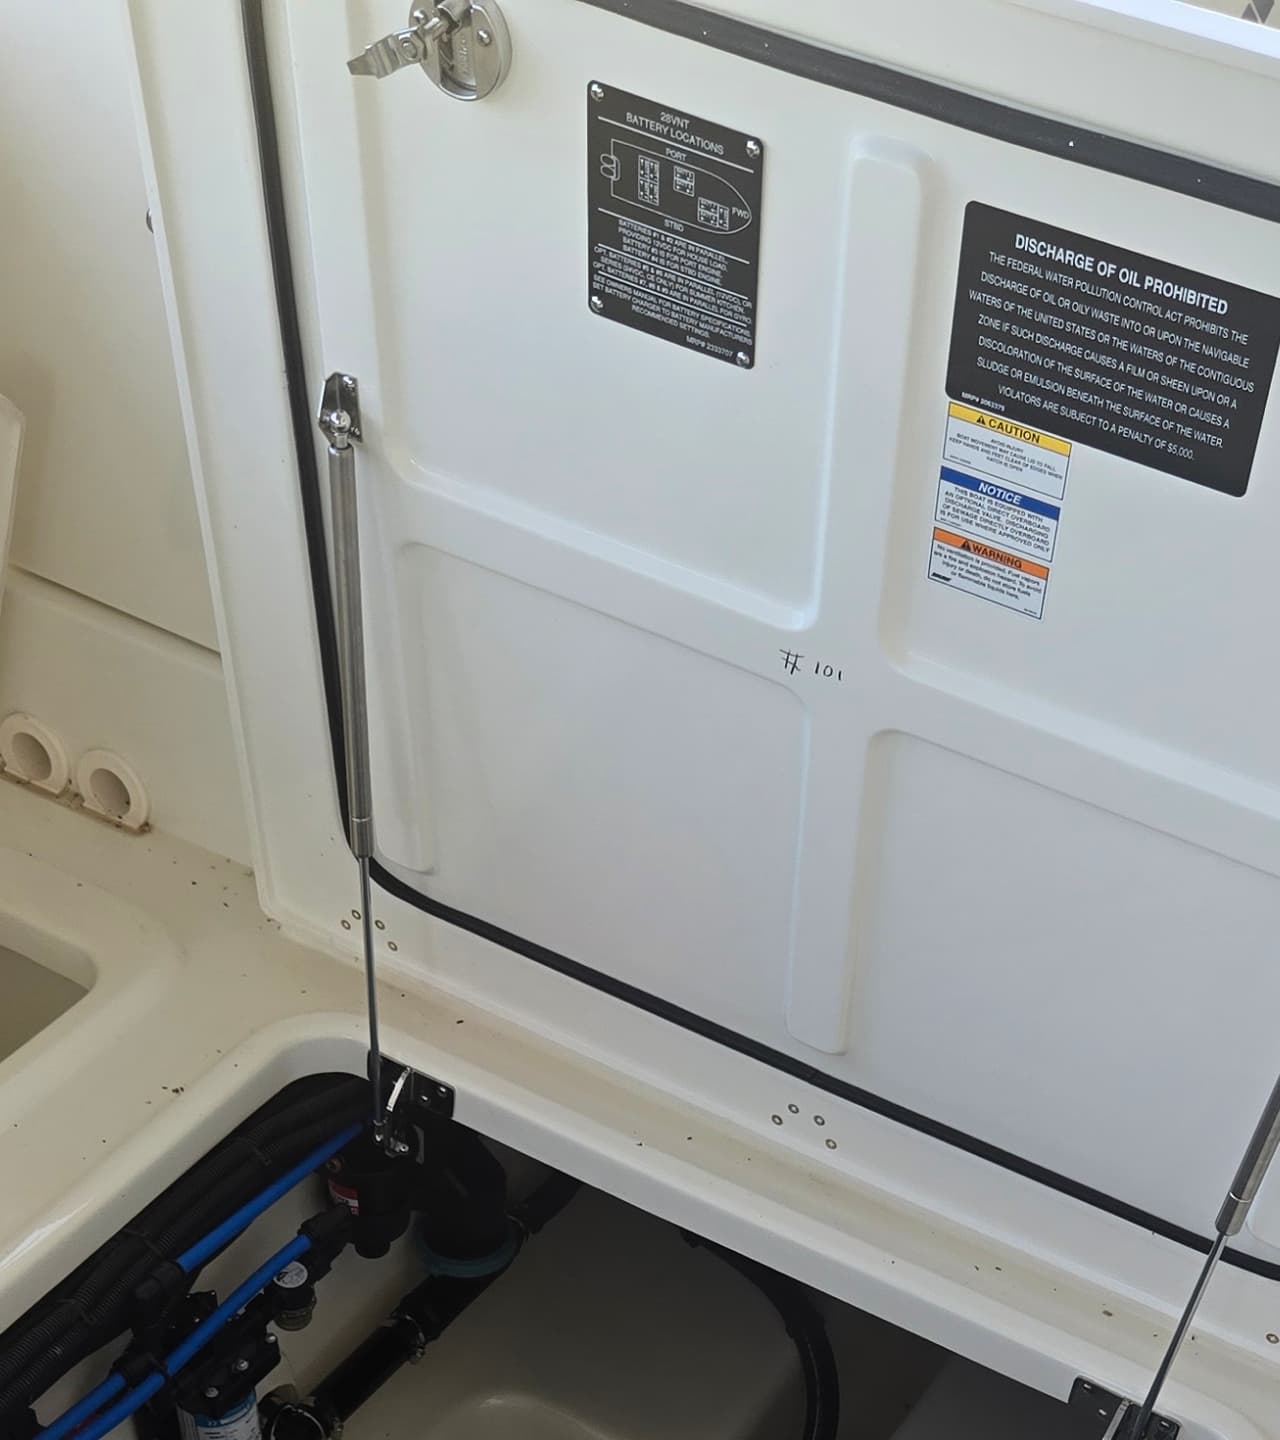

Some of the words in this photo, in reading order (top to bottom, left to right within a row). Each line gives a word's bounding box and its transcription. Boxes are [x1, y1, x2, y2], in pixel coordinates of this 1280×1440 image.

[625, 112, 668, 136] BATTERY
[670, 127, 724, 155] LOCATIONS
[660, 111, 689, 130] 28VNT
[665, 147, 686, 162] PORT
[731, 206, 749, 220] FWD
[1014, 233, 1094, 273] DISCHARGE
[1095, 259, 1117, 280] OF
[1117, 266, 1142, 288] OIL
[1142, 274, 1229, 316] PROHIBITED
[980, 270, 1028, 296] DISCHARGE
[1028, 286, 1041, 300] OF
[1041, 290, 1056, 305] OIL
[1055, 295, 1070, 310] OR
[1069, 300, 1090, 316] OILY
[1090, 306, 1120, 326] WASTE
[1120, 316, 1142, 333] INTO
[1141, 323, 1156, 338] OR
[1156, 328, 1182, 346] UPON
[1181, 336, 1200, 352] THE
[1200, 343, 1250, 368] NAVIGABLE
[988, 250, 1006, 267] THE
[1006, 256, 1044, 279] FEDERAL
[1044, 268, 1075, 289] WATER
[1074, 278, 1122, 305] POLLUTION
[1122, 294, 1164, 318] CONTROL
[1164, 307, 1183, 324] ACT
[1182, 313, 1230, 339] PROHIBITS
[1229, 329, 1249, 346] THE
[968, 288, 1002, 310] WATERS
[1002, 300, 1015, 315] OF
[1015, 304, 1033, 320] THE
[1032, 310, 1064, 331] UNITED
[1063, 320, 1096, 341] STATES
[1096, 331, 1110, 346] OR
[1110, 336, 1129, 352] THE
[1128, 342, 1165, 364] WATERS
[1165, 354, 1179, 368] OF
[1178, 358, 1197, 375] THE
[1196, 364, 1255, 394] CONTIGUOUS
[977, 313, 1000, 331] ZONE
[1000, 321, 1009, 334] IF
[1009, 324, 1033, 342] SUCH
[1033, 332, 1082, 358] DISCHARGE
[1082, 348, 1117, 370] CAUSES
[1117, 360, 1124, 372] A
[1124, 362, 1145, 379] FILM
[1145, 369, 1159, 384] OR
[1159, 374, 1189, 394] SHEEN
[1189, 384, 1215, 402] UPON
[1215, 393, 1230, 407] OR
[1230, 398, 1238, 410] A
[976, 356, 1008, 376] SLUDGE
[1008, 367, 1022, 381] OR
[1022, 371, 1064, 395] EMULSION
[1063, 386, 1102, 408] BENEATH
[1102, 399, 1120, 414] THE
[1119, 405, 1159, 427] SURFACE
[1159, 418, 1173, 432] OF
[1172, 423, 1191, 438] THE
[1190, 429, 1224, 449] WATER.
[977, 335, 1042, 367] DISCOLORATION
[1042, 357, 1055, 371] OF
[1055, 361, 1072, 377] THE
[1072, 367, 1112, 390] SURFACE
[1111, 380, 1125, 394] OF
[1124, 385, 1143, 400] THE
[1142, 391, 1173, 411] WATER
[1173, 401, 1188, 415] OR
[1187, 406, 1223, 427] CAUSES
[1222, 418, 1231, 430] A
[987, 417, 1040, 444] CAUTION
[997, 384, 1042, 409] VIOLATORS
[1042, 399, 1059, 415] ARE
[1059, 405, 1096, 427] SUBJECT
[1096, 418, 1109, 432] TO
[1109, 422, 1116, 434] A
[1116, 424, 1154, 447] PENALTY
[1153, 437, 1167, 451] OF
[1166, 442, 1195, 461] $5,000.
[944, 489, 954, 498] AN
[954, 493, 986, 510] OPTIONAL
[986, 505, 1010, 518] DIRECT
[1010, 513, 1050, 533] OVERBOARD
[953, 486, 968, 496] THIS
[969, 491, 986, 503] BOAT
[994, 501, 1026, 517] EQUIPPED
[1026, 512, 1043, 523] WITH
[978, 481, 1022, 505] NOTICE
[939, 508, 946, 516] IS
[946, 511, 960, 521] FOR
[961, 516, 974, 526] USE
[974, 521, 998, 535] WHERE
[998, 530, 1032, 547] APPROVED
[1032, 542, 1050, 554] ONLY
[941, 502, 951, 511] OF
[951, 506, 979, 521] SEWAGE
[979, 516, 1010, 532] DIRECTLY
[1010, 527, 1049, 547] OVERBOARD
[944, 496, 981, 515] DISCHARGE
[981, 510, 1004, 523] VALVE.
[1004, 518, 1049, 539] DISCHARGING
[972, 544, 1022, 569] WARNING
[814, 661, 843, 681] 101
